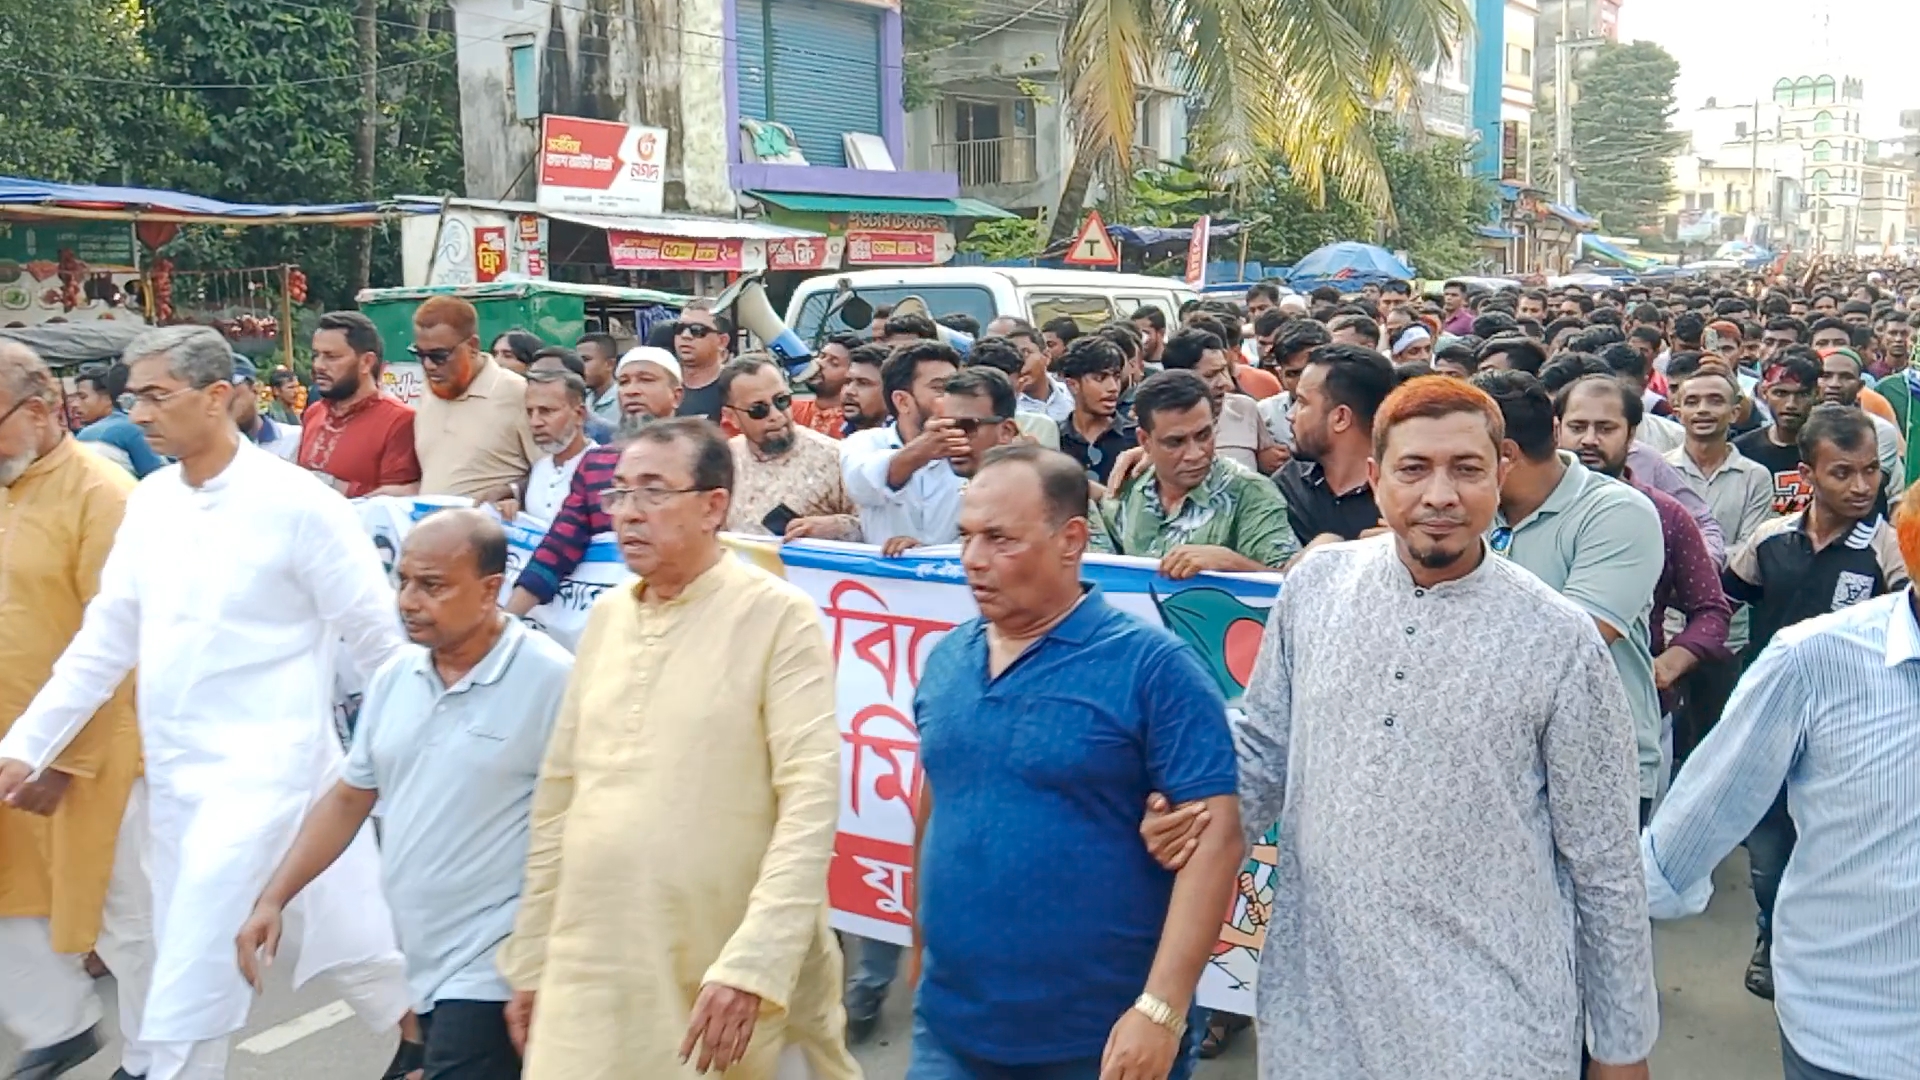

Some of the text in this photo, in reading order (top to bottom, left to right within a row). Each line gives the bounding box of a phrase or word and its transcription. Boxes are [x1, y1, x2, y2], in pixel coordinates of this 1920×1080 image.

[631, 163, 660, 181] নগদ
[841, 704, 920, 819] মি
[852, 855, 912, 920] যু
